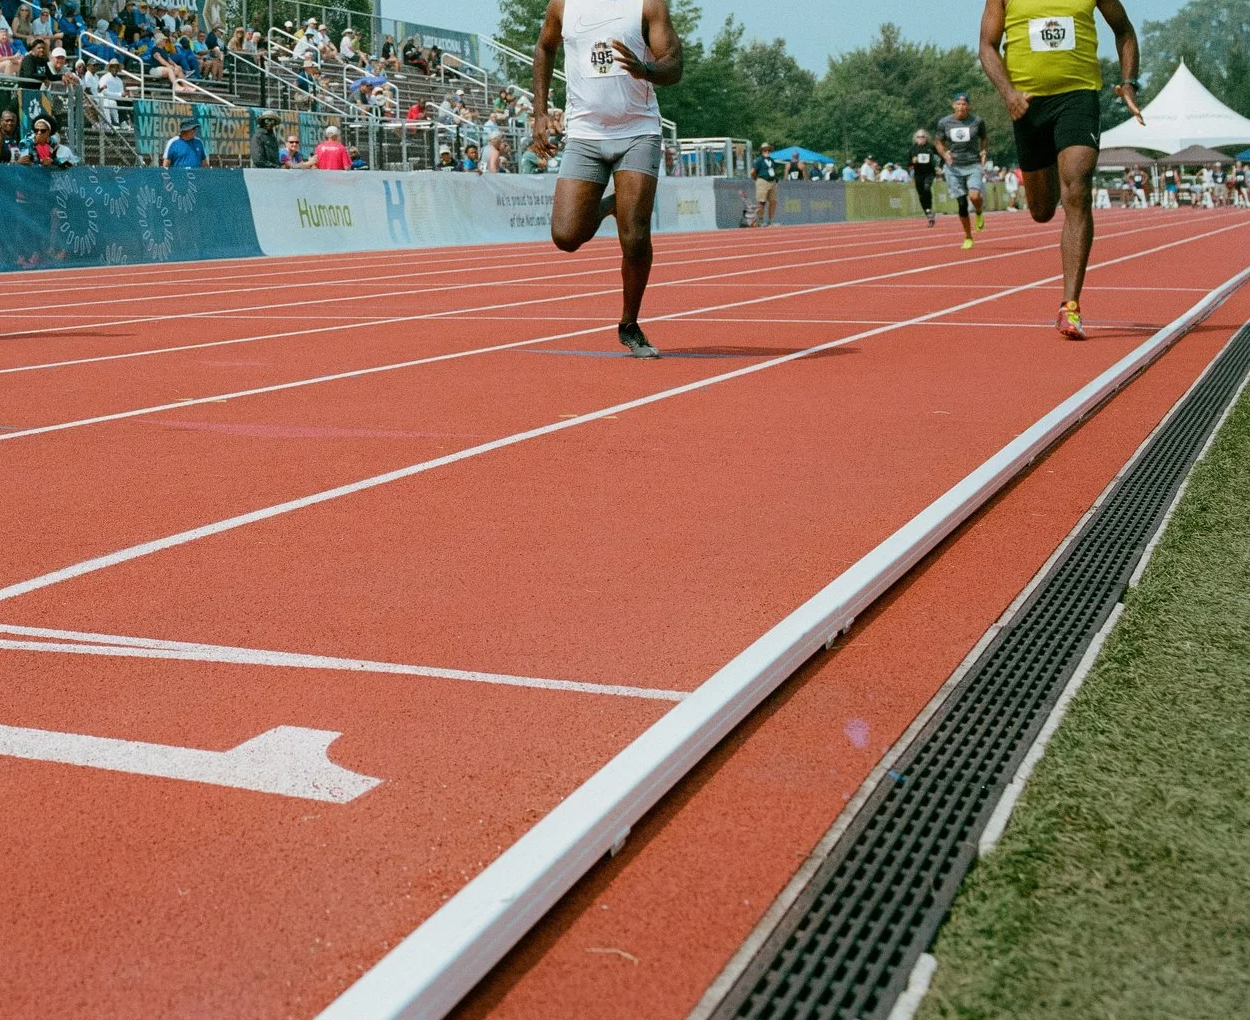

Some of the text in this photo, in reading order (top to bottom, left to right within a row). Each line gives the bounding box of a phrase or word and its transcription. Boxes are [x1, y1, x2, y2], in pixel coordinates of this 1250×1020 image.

[1041, 28, 1066, 40] 1637
[591, 50, 613, 65] 495
[197, 117, 250, 138] WELCOME
[297, 199, 351, 228] Humana
